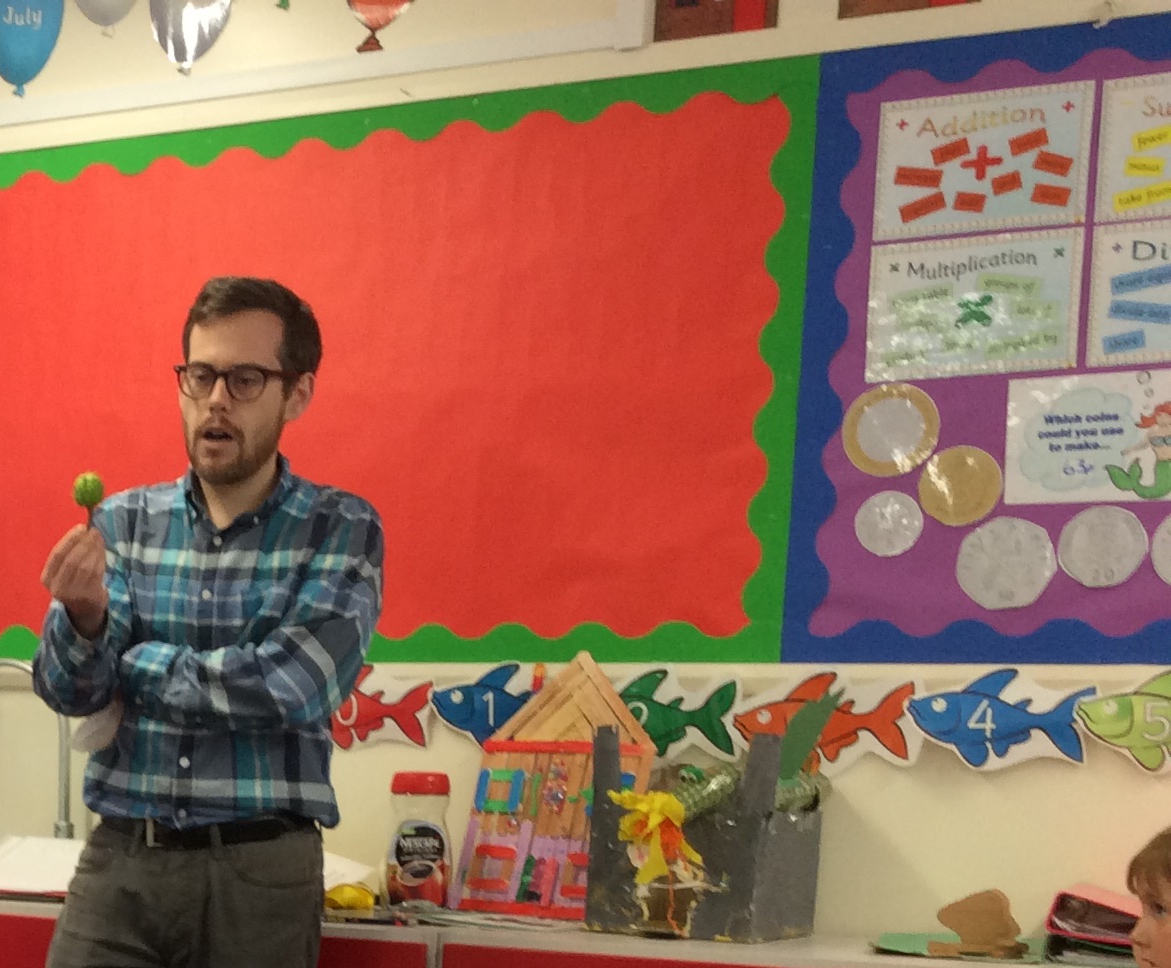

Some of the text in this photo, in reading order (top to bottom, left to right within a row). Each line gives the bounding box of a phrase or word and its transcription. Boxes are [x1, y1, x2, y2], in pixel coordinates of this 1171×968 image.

[2, 8, 43, 31] July
[916, 105, 1046, 138] Addition
[907, 249, 1039, 281] Multiplication
[481, 690, 495, 728] 1
[966, 699, 997, 738] 4
[1141, 701, 1171, 742] 5
